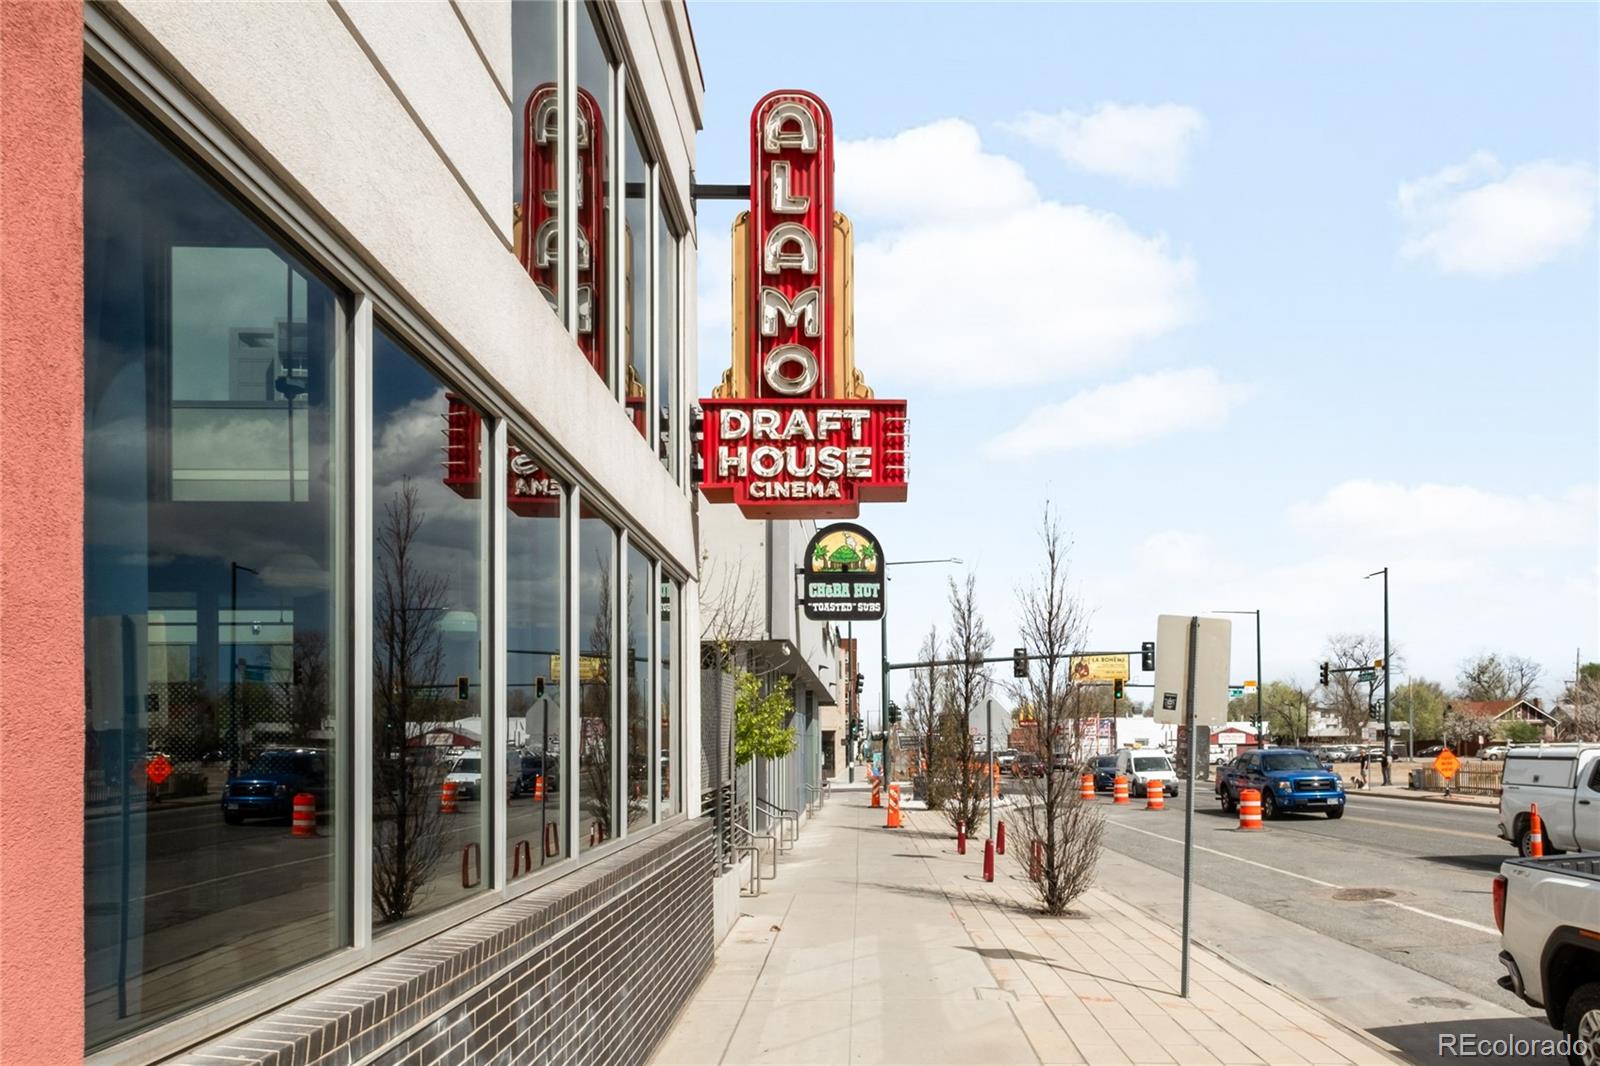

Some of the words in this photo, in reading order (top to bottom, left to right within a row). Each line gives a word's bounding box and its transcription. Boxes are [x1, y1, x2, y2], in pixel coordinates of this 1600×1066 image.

[760, 102, 823, 396] ALAMO
[718, 408, 871, 441] DRAFT
[717, 445, 873, 478] HOUSE
[748, 481, 842, 499] CINEMA
[853, 582, 881, 598] HUT
[857, 602, 881, 612] SUBS
